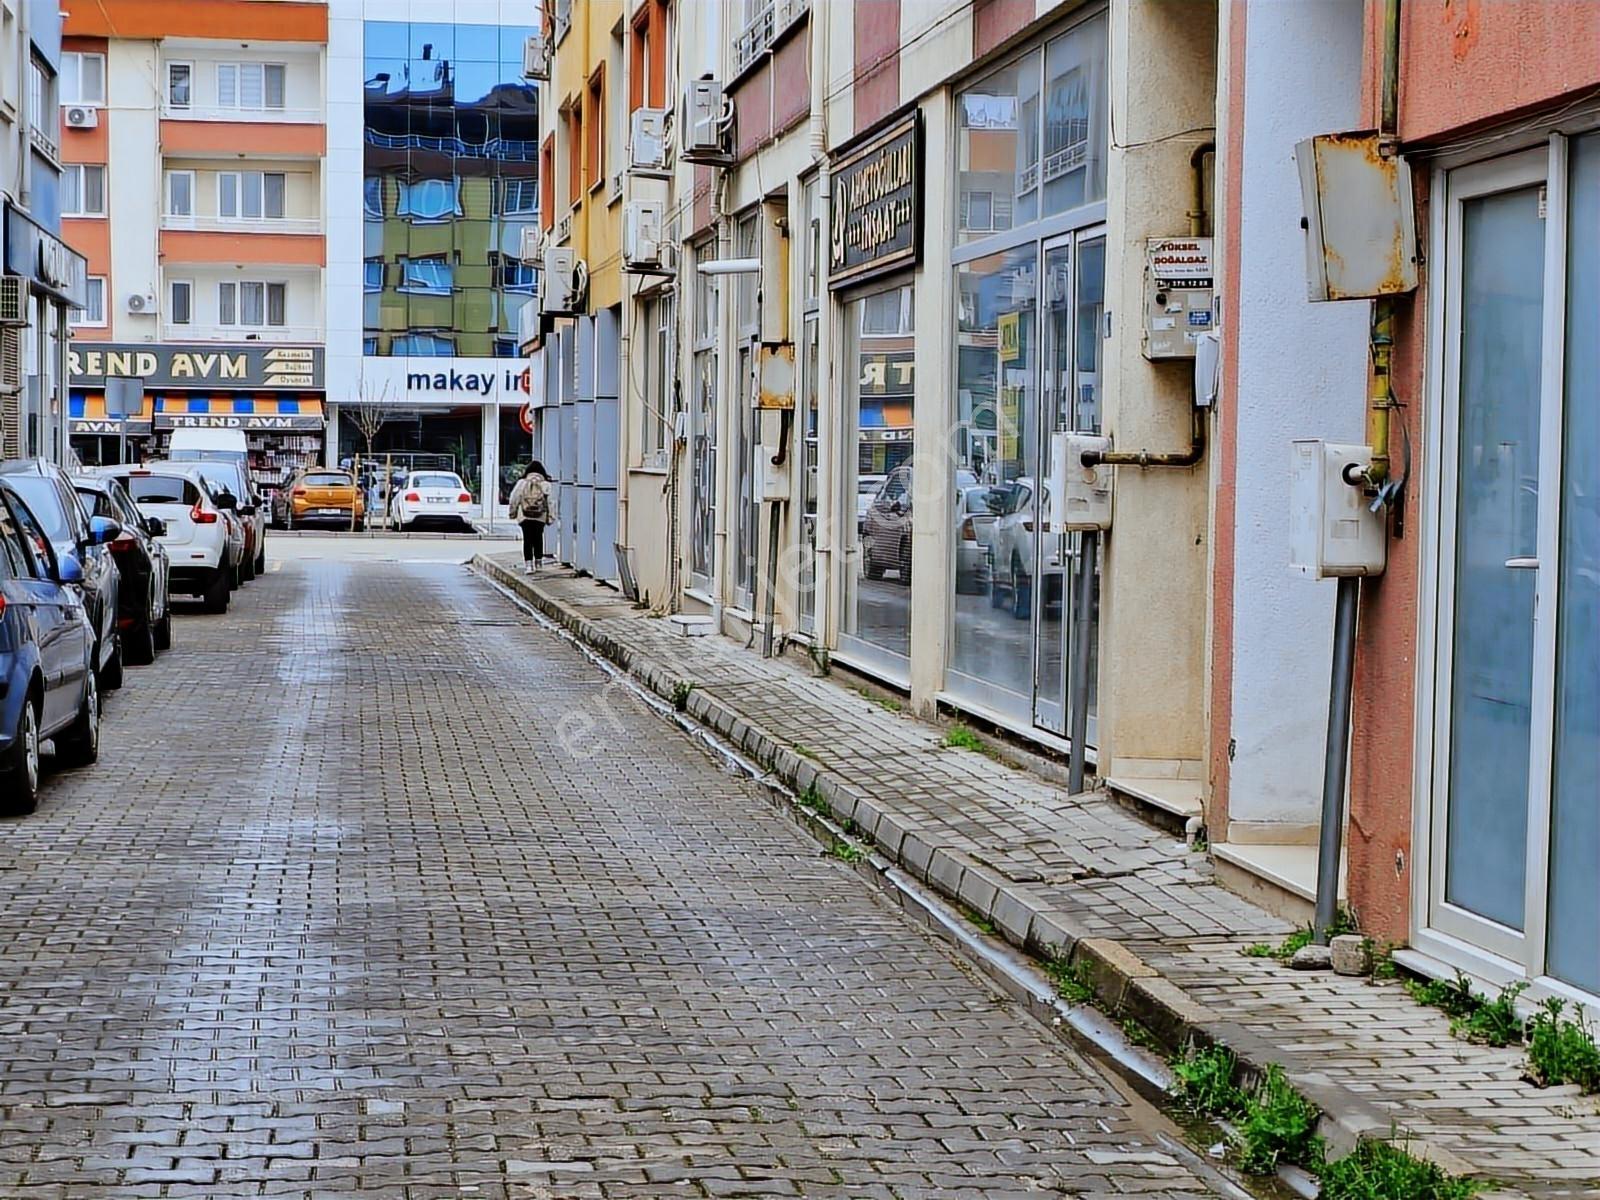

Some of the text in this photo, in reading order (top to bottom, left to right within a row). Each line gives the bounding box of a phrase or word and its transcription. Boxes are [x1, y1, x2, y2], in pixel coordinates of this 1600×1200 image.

[1160, 242, 1200, 251] YÜKSEL
[1154, 255, 1207, 265] DOĞALGAZ
[171, 353, 247, 378] AVM
[407, 368, 495, 396] makay
[75, 422, 121, 433] AVM
[169, 417, 292, 428] TREND AVM
